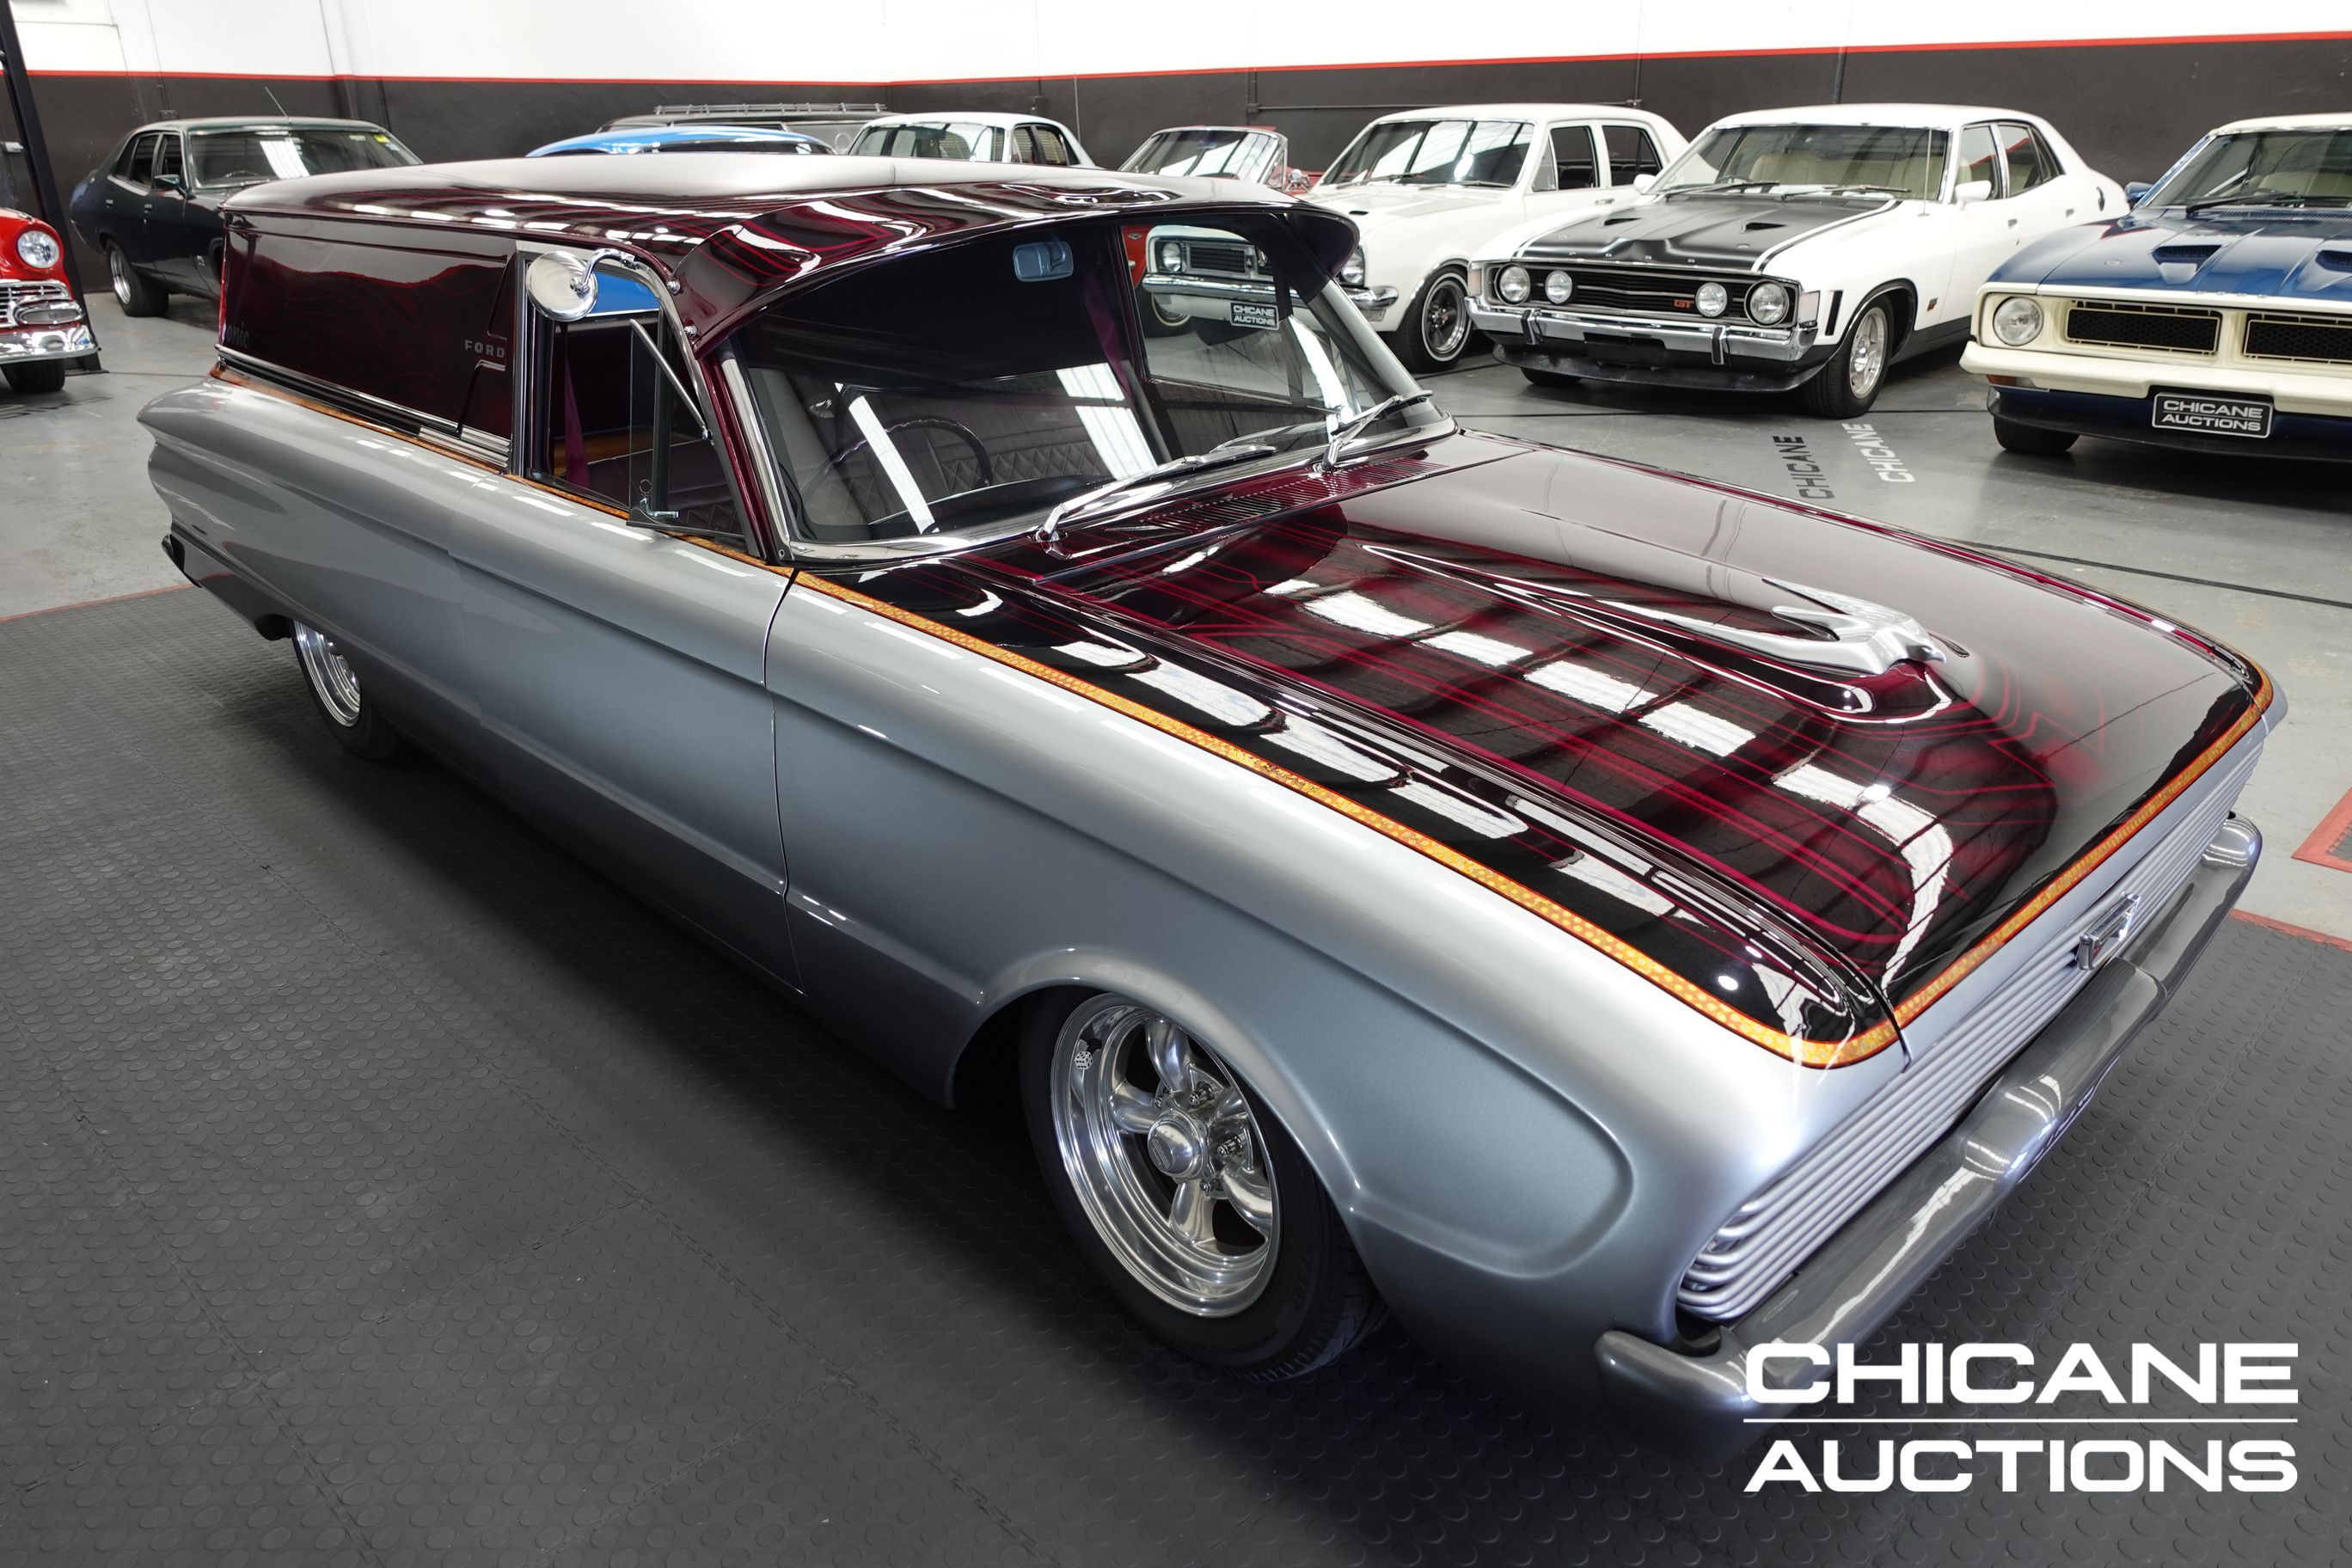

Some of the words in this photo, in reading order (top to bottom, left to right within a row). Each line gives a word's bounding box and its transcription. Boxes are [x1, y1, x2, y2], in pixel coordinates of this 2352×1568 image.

[1233, 305, 1275, 317] CHICANE
[1673, 298, 1694, 309] GT
[1234, 315, 1275, 326] AUCTIONS
[464, 340, 505, 358] FORD
[2163, 400, 2263, 419] CHICANE
[2161, 413, 2262, 432] AUCTIONS
[1841, 423, 1915, 483] CHICANE
[1772, 435, 1835, 499] CHICANE
